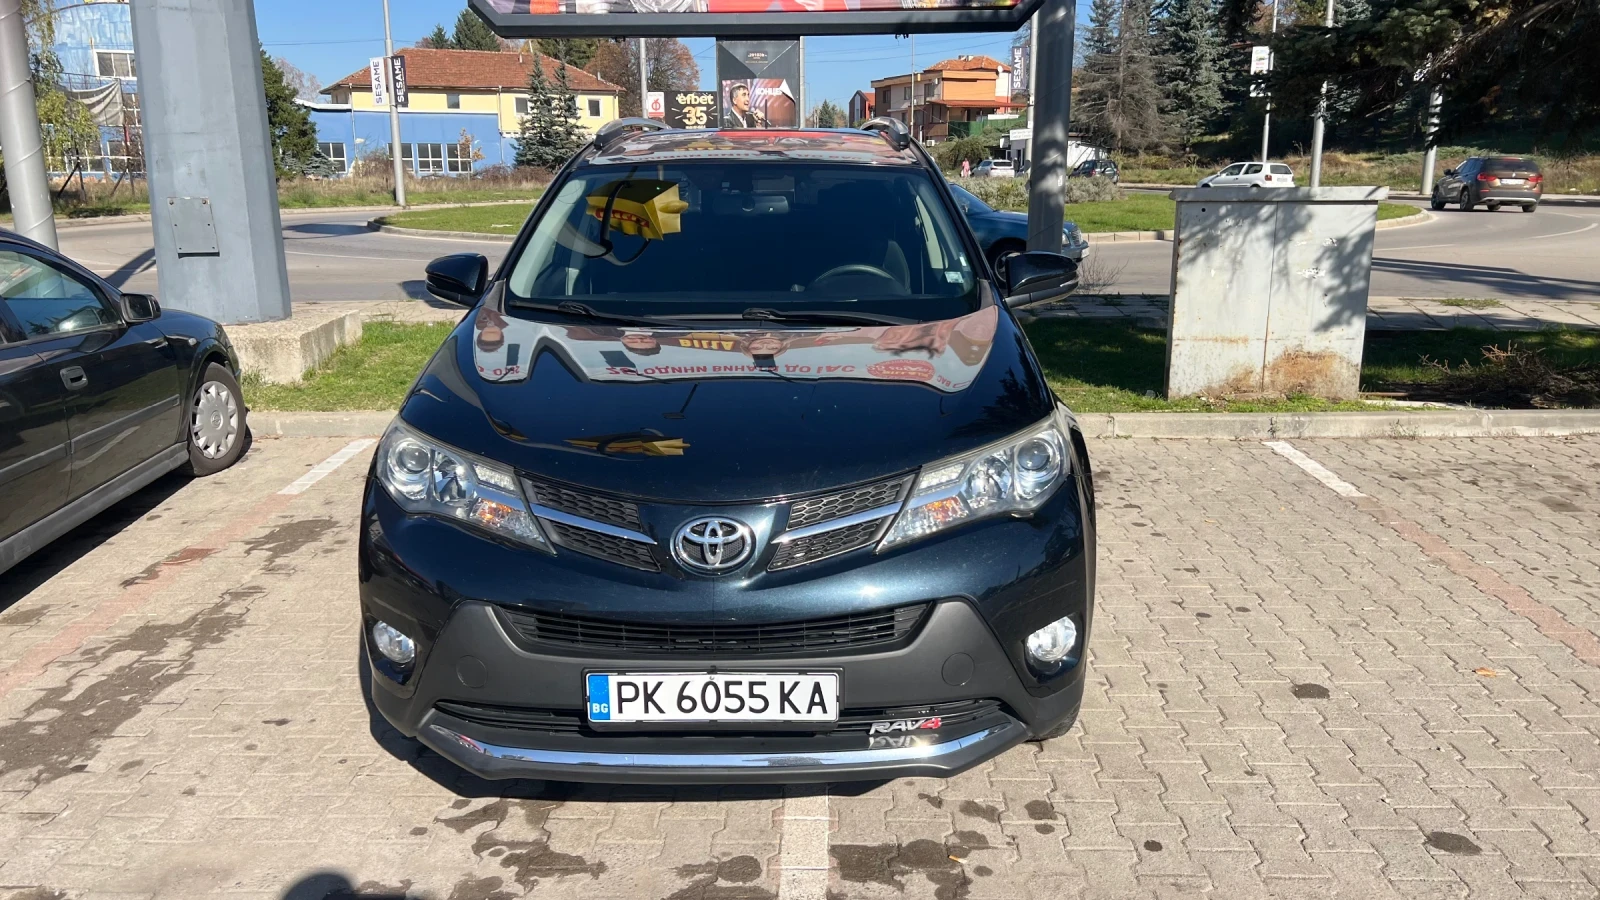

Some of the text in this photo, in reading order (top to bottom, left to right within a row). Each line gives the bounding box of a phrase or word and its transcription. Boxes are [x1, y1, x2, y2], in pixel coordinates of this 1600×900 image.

[373, 61, 382, 103] SESAME
[394, 58, 404, 102] SESAME
[678, 92, 714, 105] efbet
[682, 106, 707, 125] 35
[616, 681, 828, 714] PK 6055 KA
[592, 703, 609, 713] BG
[869, 717, 942, 735] RAV4
